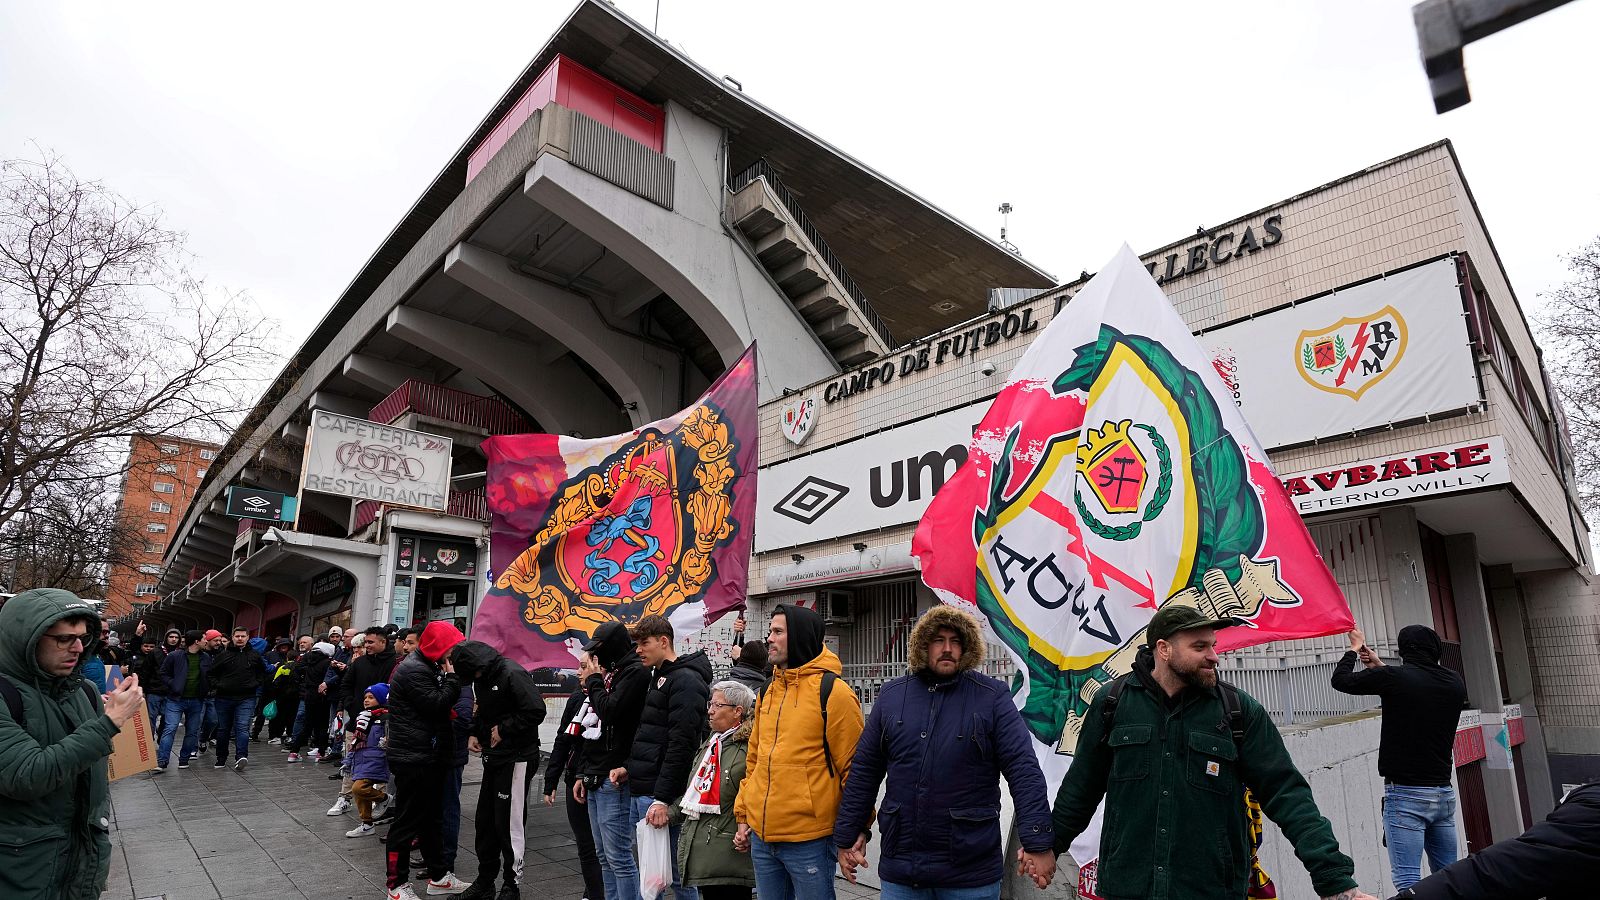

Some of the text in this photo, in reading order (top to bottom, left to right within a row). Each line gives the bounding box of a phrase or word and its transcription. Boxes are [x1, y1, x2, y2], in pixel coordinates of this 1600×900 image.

[824, 361, 895, 403] CAMPO
[898, 348, 931, 377] DE
[870, 424, 979, 508] um
[306, 474, 444, 508] RESTAURANTE
[1299, 472, 1491, 511] ETERNO WILLY
[785, 565, 860, 581] Fundación Rayo Vallecano
